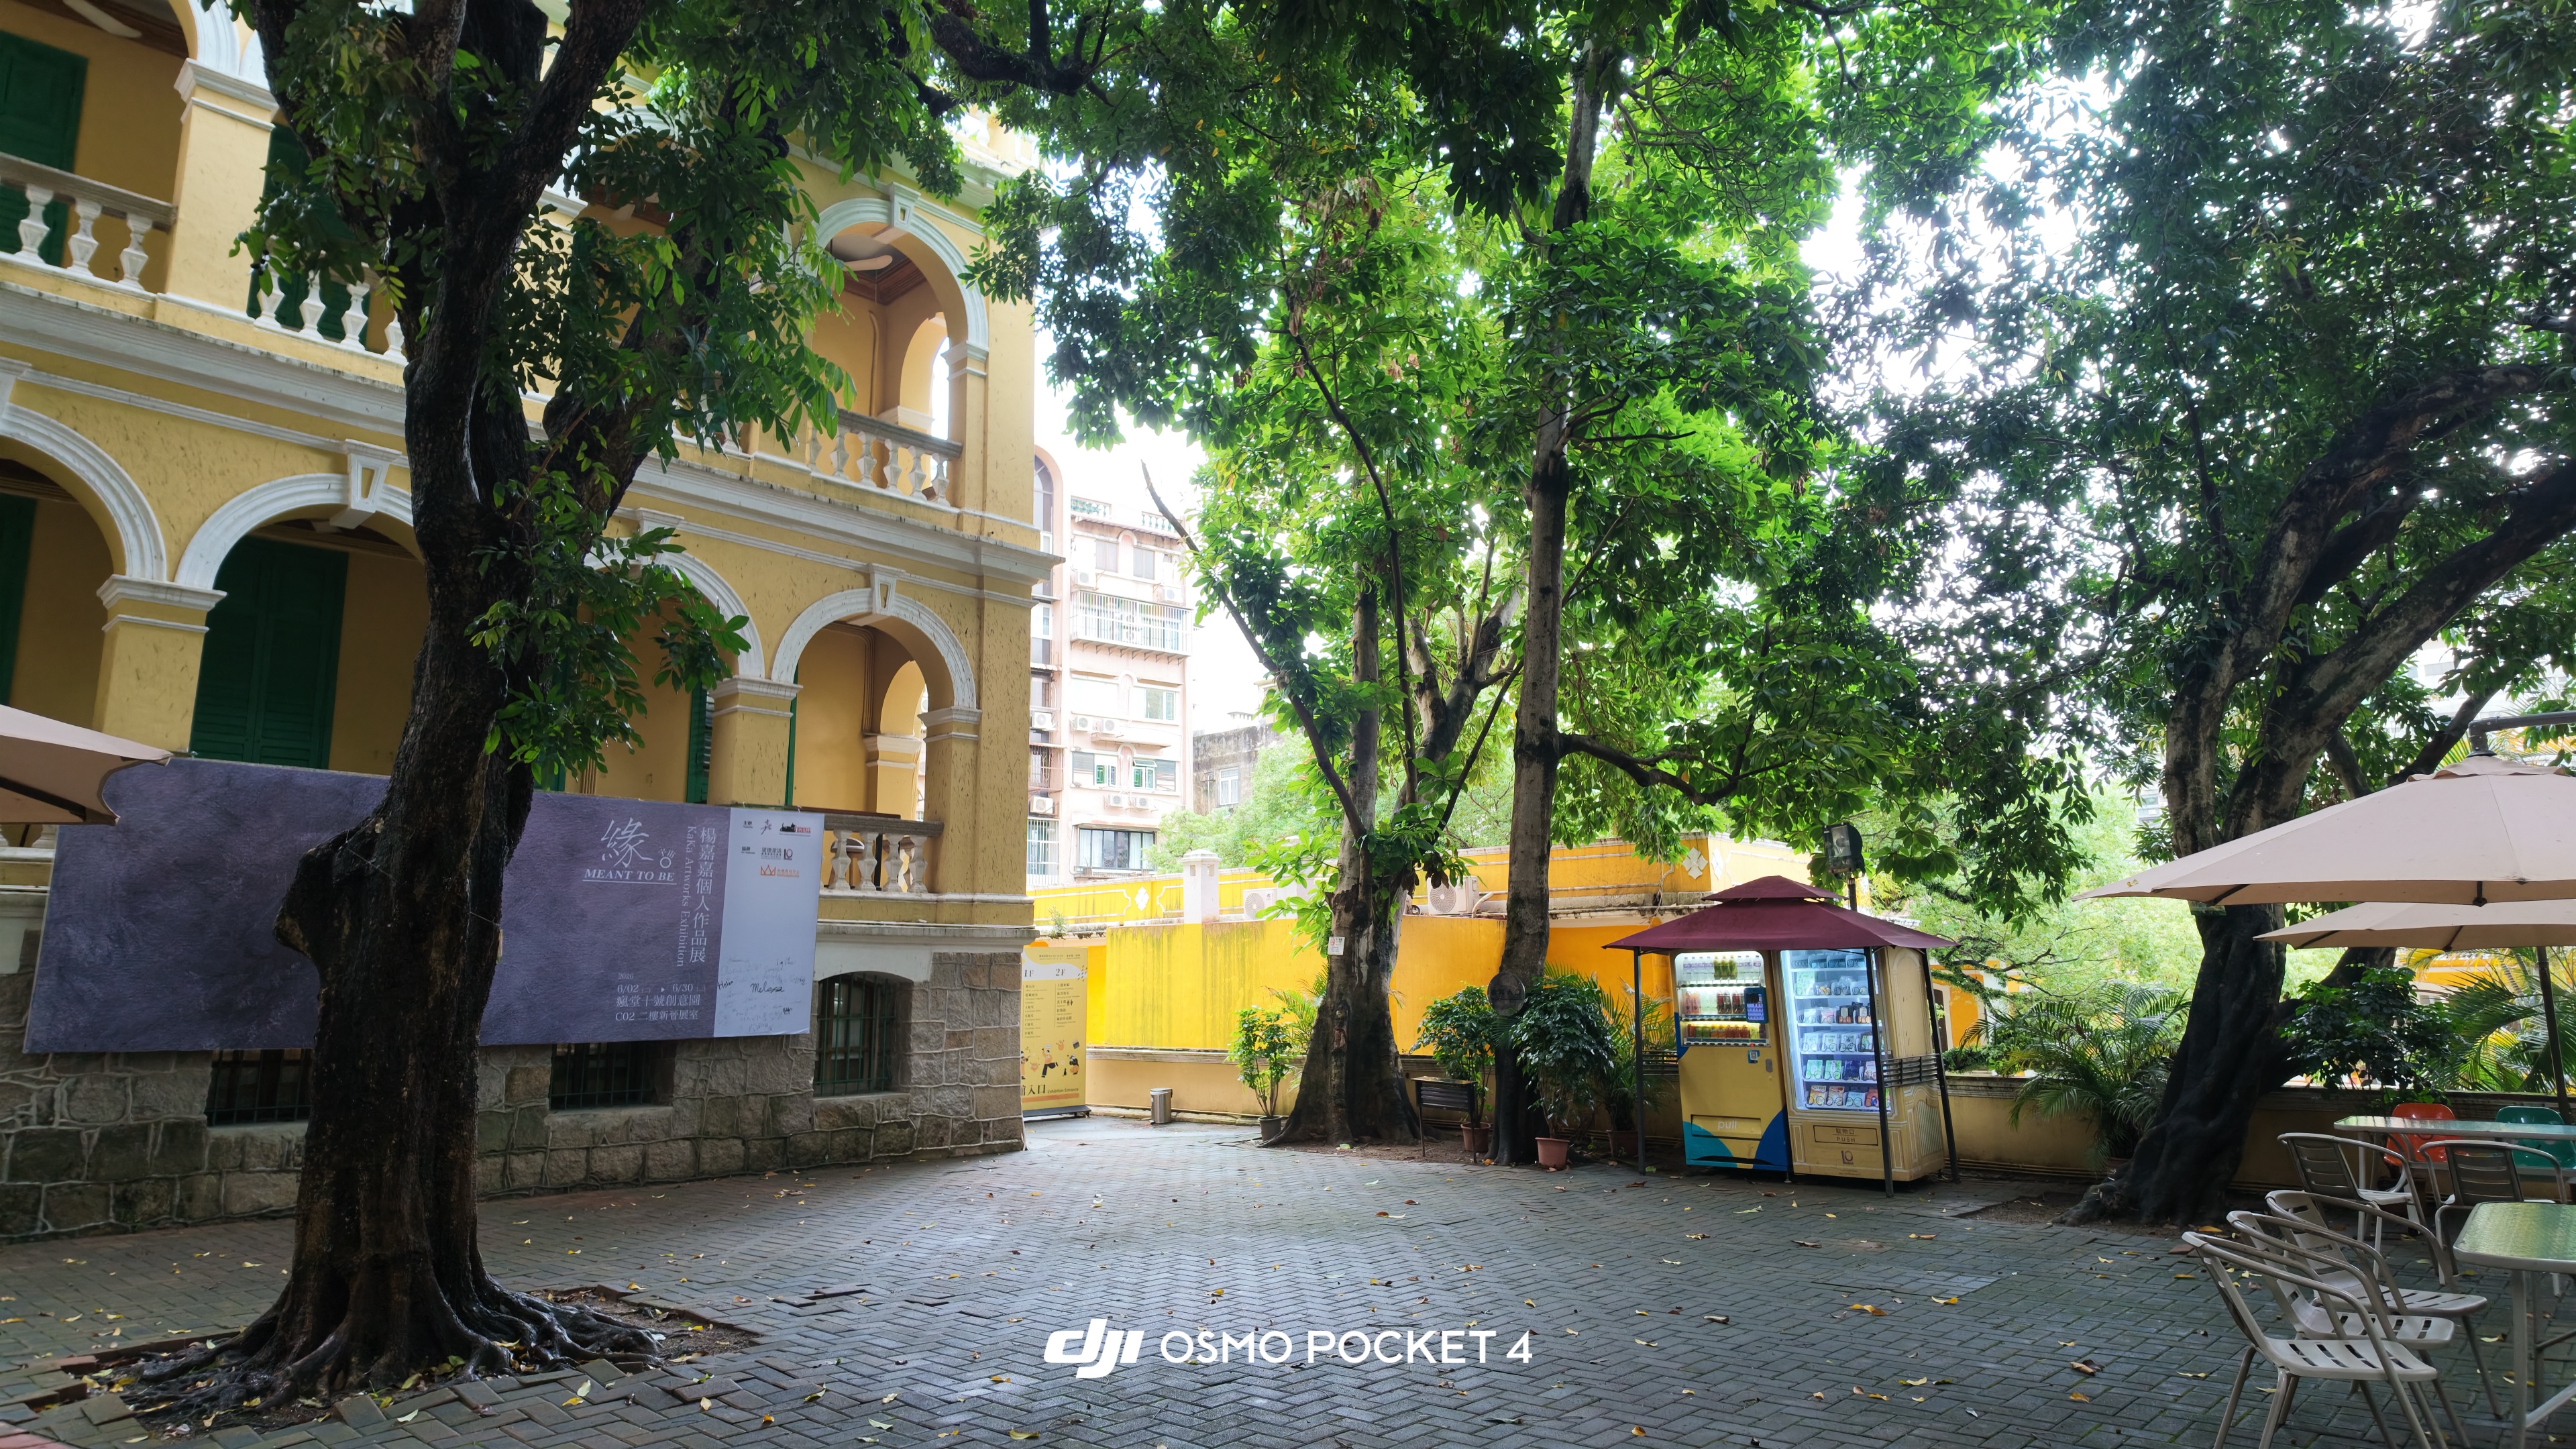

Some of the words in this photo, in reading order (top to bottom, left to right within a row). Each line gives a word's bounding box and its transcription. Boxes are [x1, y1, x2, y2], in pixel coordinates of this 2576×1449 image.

[686, 826, 697, 853] KaKa
[584, 869, 633, 879] MEANT
[637, 871, 654, 880] TO
[658, 872, 675, 881] BE
[682, 857, 694, 907] Artworks
[689, 826, 716, 963] 楊嘉嘉個人作品展
[676, 910, 690, 967] Exhibition
[1055, 968, 1065, 976] 2F
[617, 984, 639, 994] 6/02
[672, 983, 693, 993] 6/30
[1717, 1120, 1737, 1130] pull
